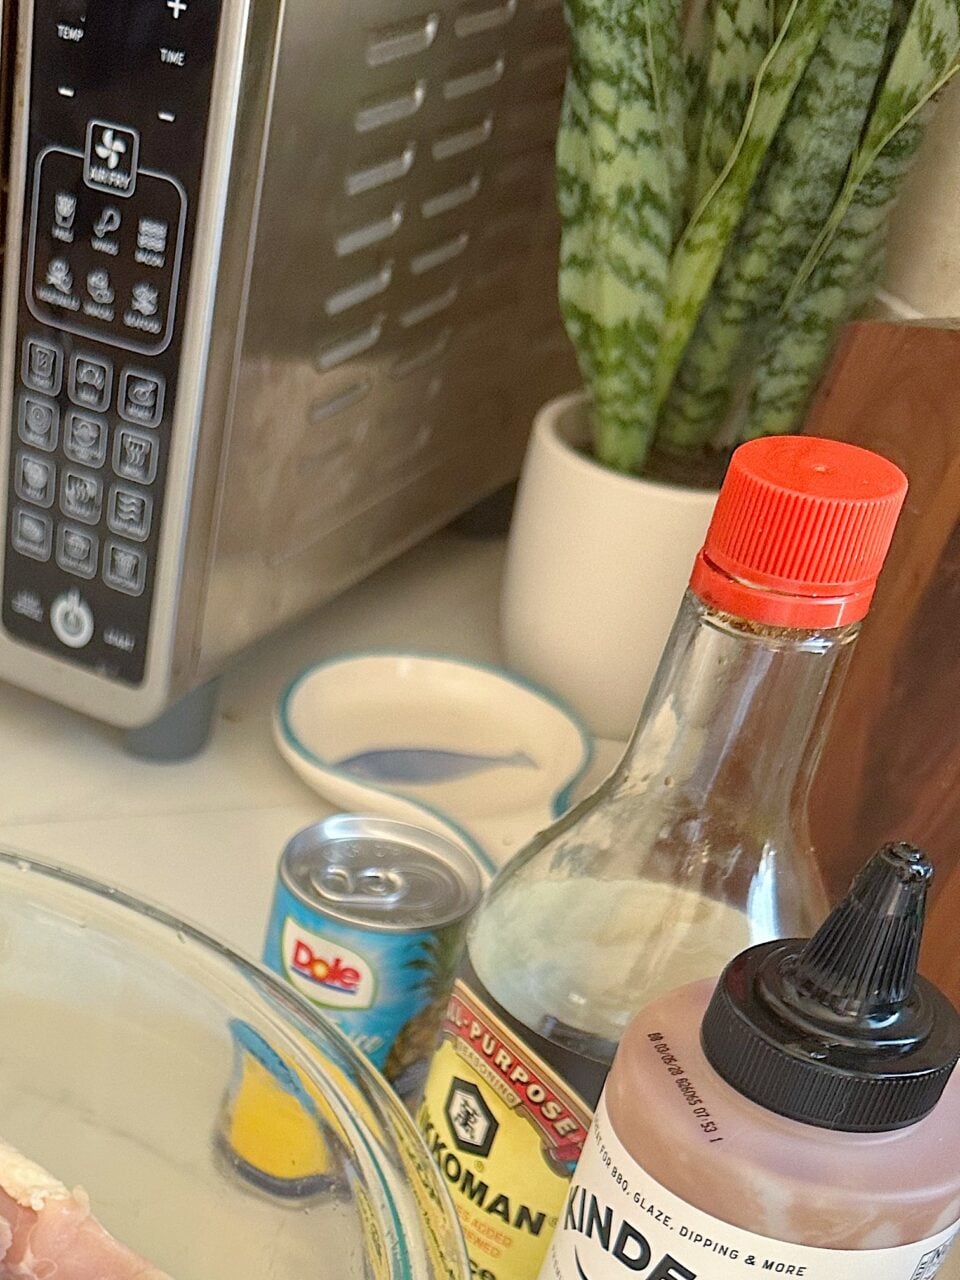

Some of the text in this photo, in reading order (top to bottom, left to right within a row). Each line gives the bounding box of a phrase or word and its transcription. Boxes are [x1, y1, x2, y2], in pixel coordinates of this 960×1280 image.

[57, 24, 84, 41] TEMP
[160, 48, 186, 66] TIME
[292, 939, 362, 989] Dole
[678, 1226, 740, 1260] DIPPING
[744, 1255, 756, 1266] &
[762, 1259, 808, 1277] MORE
